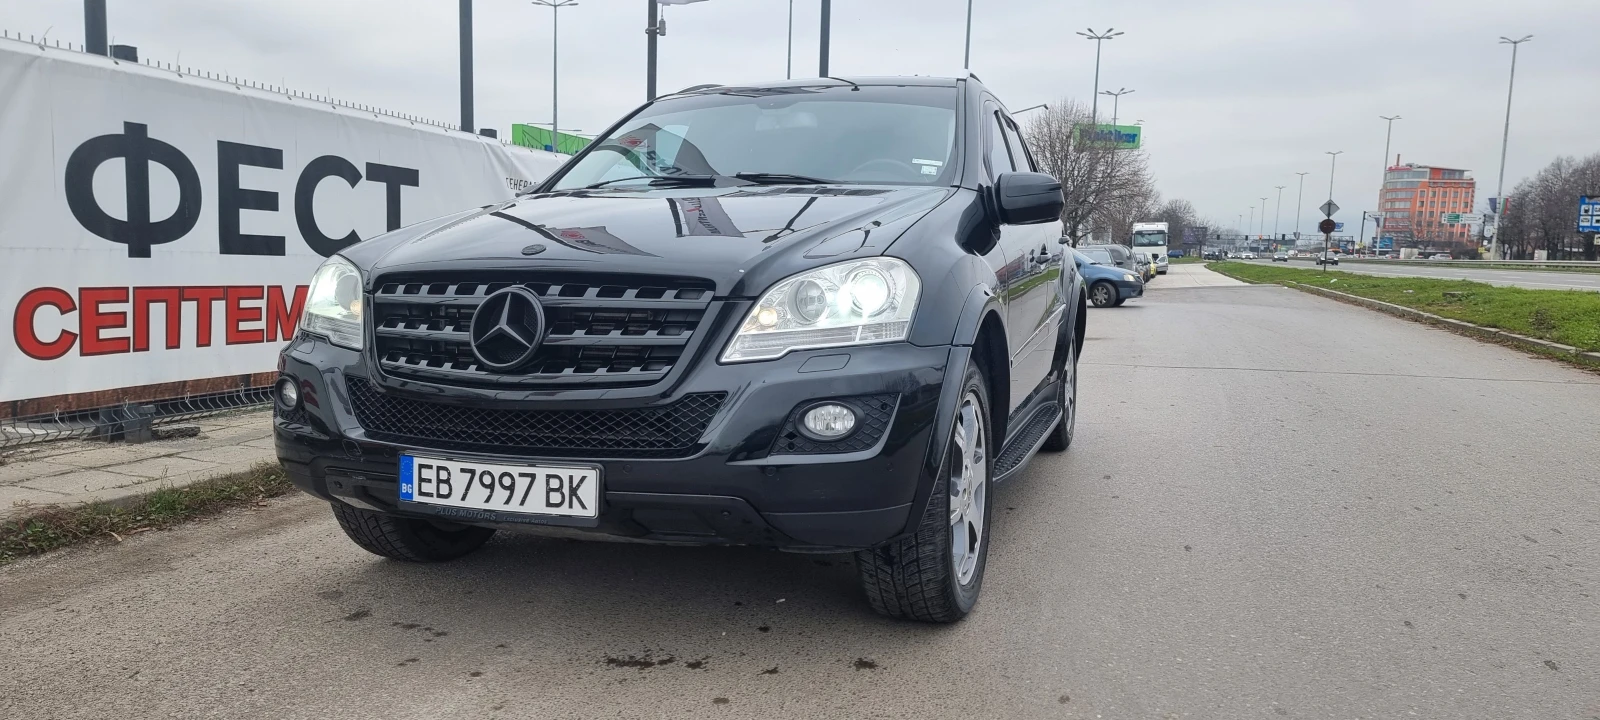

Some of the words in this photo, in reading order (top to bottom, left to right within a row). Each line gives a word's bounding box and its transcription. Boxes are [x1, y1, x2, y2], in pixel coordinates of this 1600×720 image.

[1080, 129, 1138, 143] aktiker
[65, 121, 420, 258] ФЕСТ
[505, 177, 537, 191] ГЕНЕР
[13, 284, 310, 361] СЕПТЕМ
[401, 483, 413, 494] BG
[417, 463, 453, 499] EB
[459, 468, 537, 507] 7997
[545, 474, 588, 510] BK
[435, 506, 457, 516] PLUS
[458, 509, 497, 521] MOTORS
